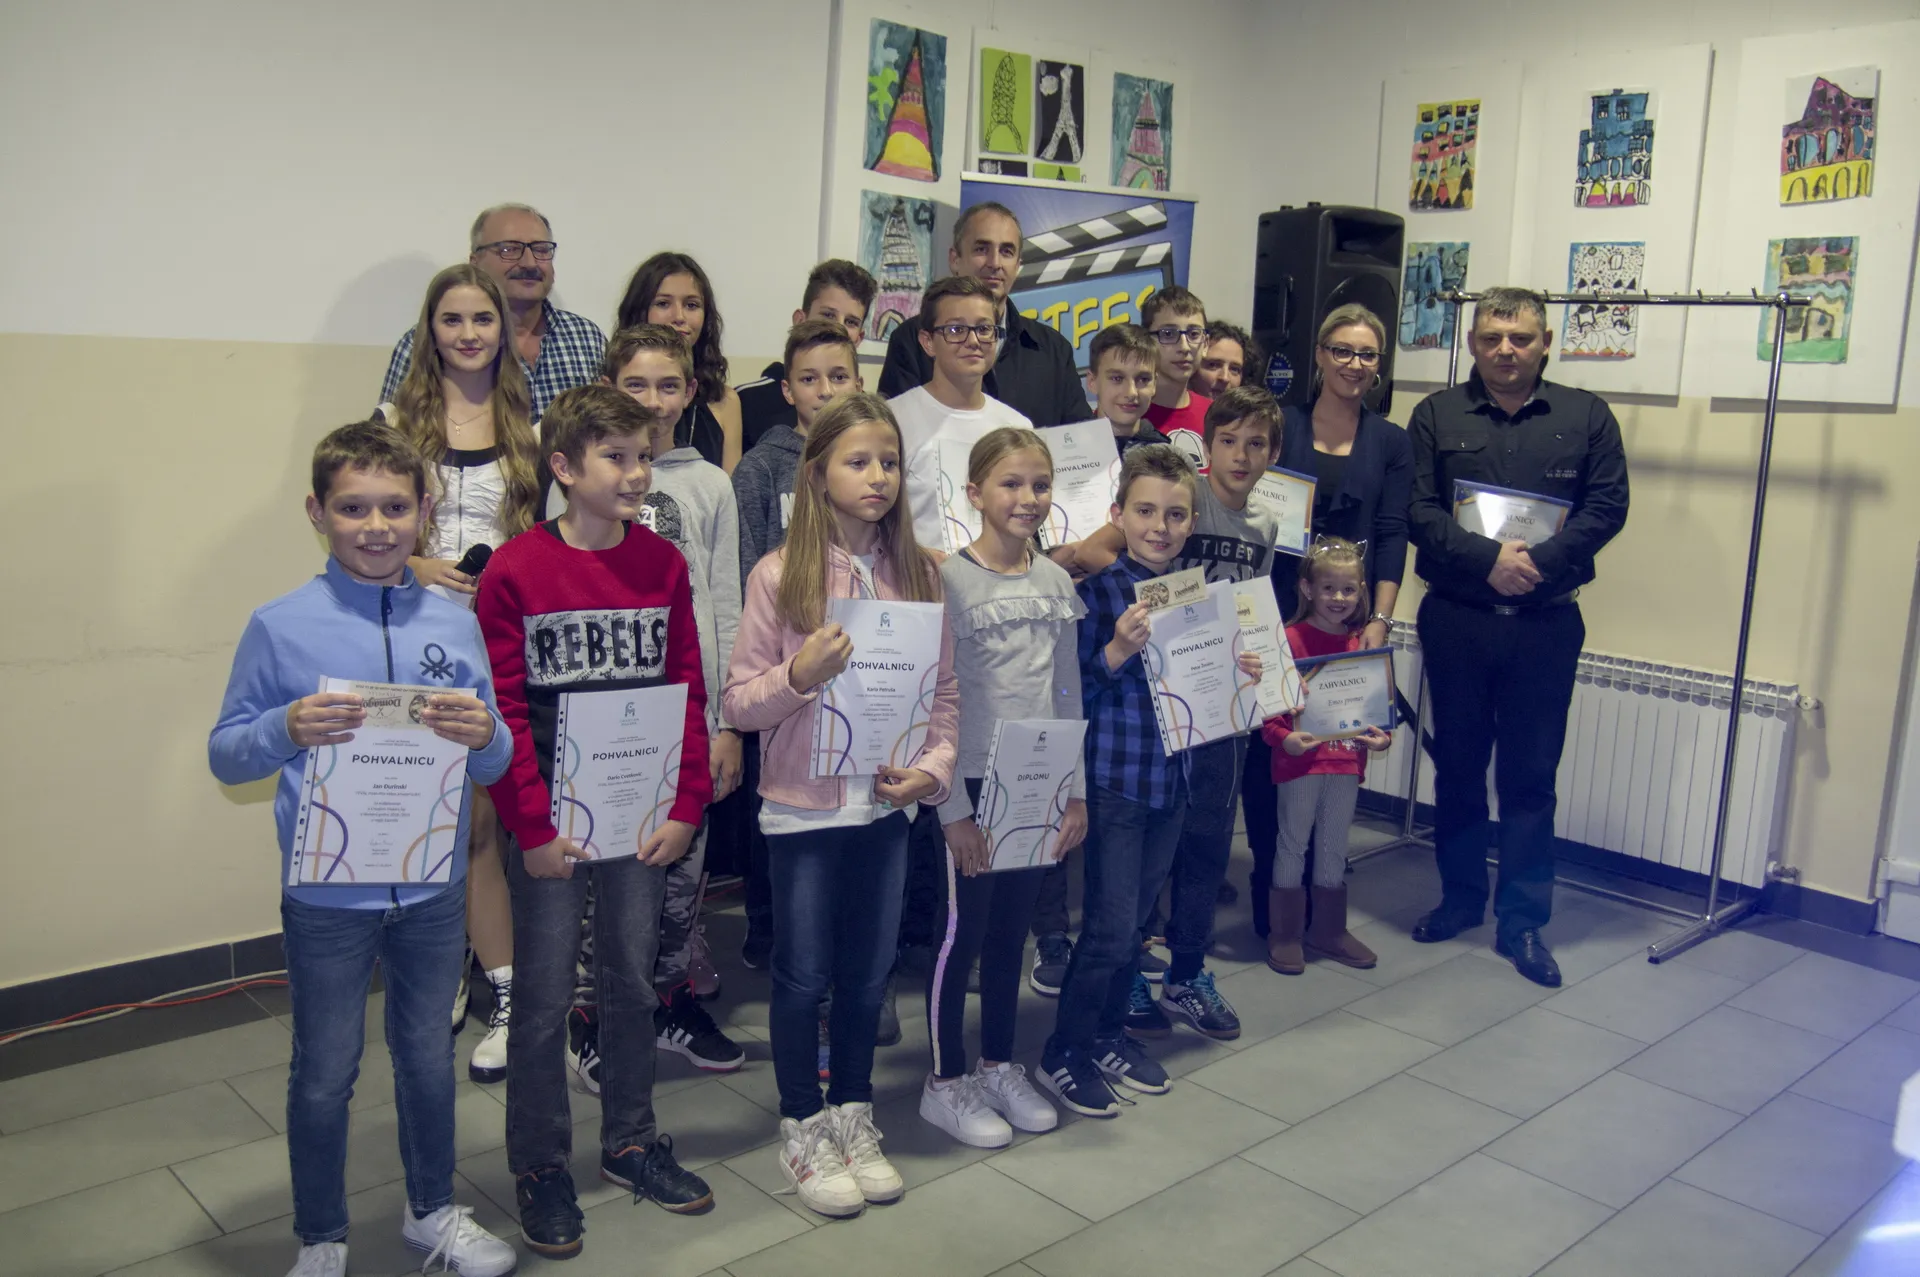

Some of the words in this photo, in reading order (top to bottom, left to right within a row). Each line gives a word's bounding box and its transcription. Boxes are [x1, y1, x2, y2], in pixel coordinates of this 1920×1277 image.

[1055, 461, 1101, 474] OHVALNICU
[1251, 487, 1289, 503] HVALNICU
[535, 618, 665, 673] REBELS
[1171, 636, 1224, 657] POHVALNICU
[850, 661, 915, 671] POHVALNICU
[1319, 676, 1367, 690] ZAHVALNICU
[362, 697, 402, 708] Domago
[352, 754, 435, 766] POHVALNICU
[592, 746, 659, 761] POHVALNICU
[1017, 773, 1050, 782] DIPLOMU
